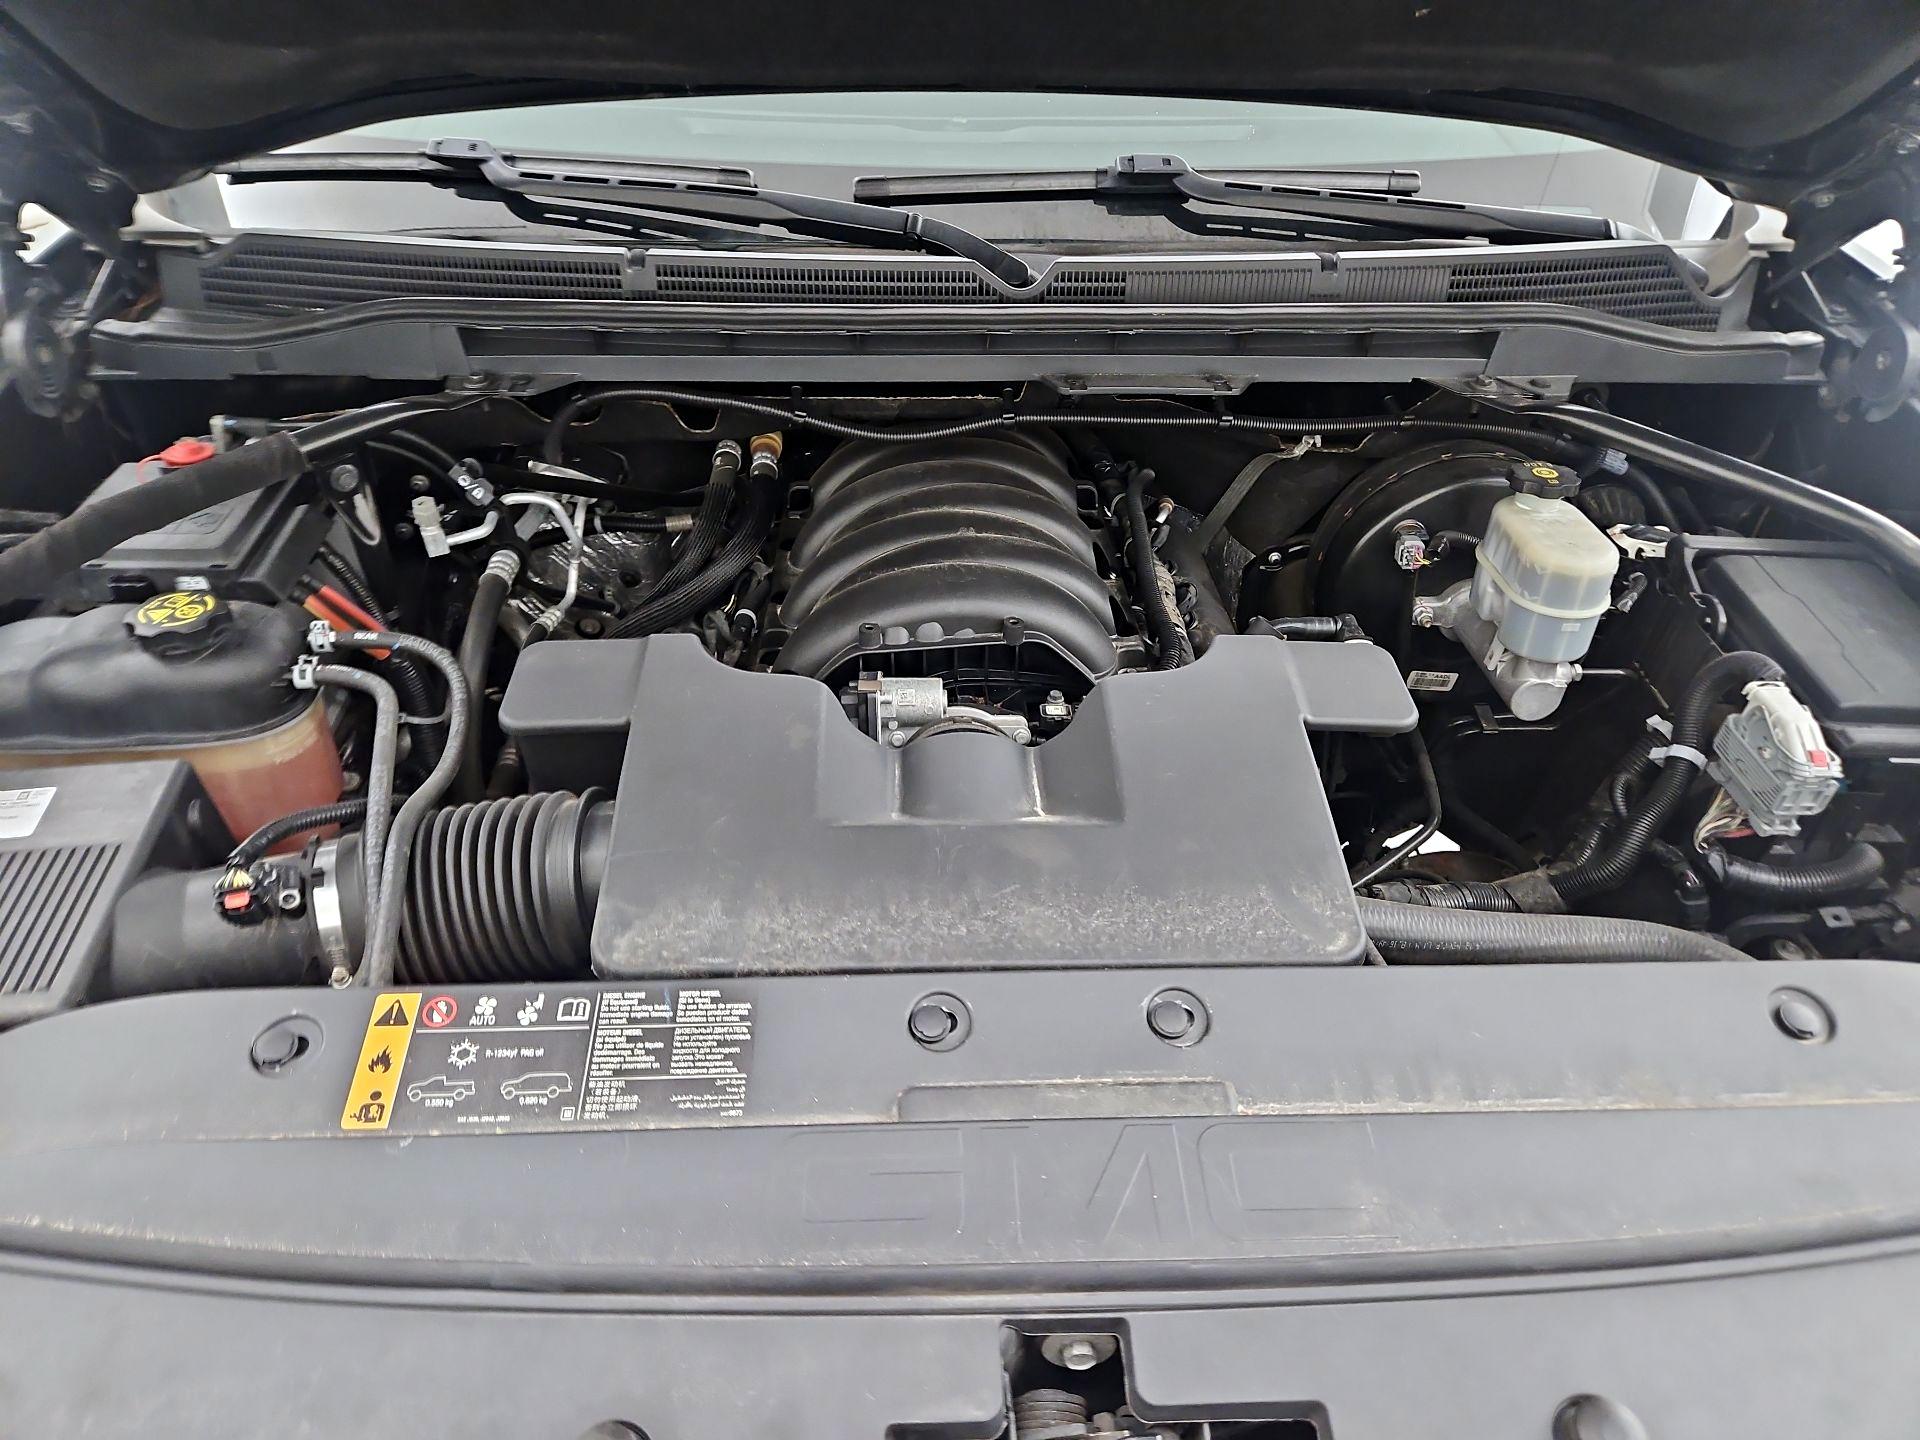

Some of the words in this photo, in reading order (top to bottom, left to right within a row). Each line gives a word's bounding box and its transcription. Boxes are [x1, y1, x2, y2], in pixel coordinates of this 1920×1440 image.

[631, 1004, 653, 1012] starting
[469, 1015, 496, 1026] AUTO
[713, 1026, 748, 1034] ДВИГАТЕЛЬ
[644, 1042, 664, 1050] liquide
[621, 1062, 652, 1070] pourraient
[539, 1096, 548, 1105] kg
[783, 1121, 1398, 1243] GMC
